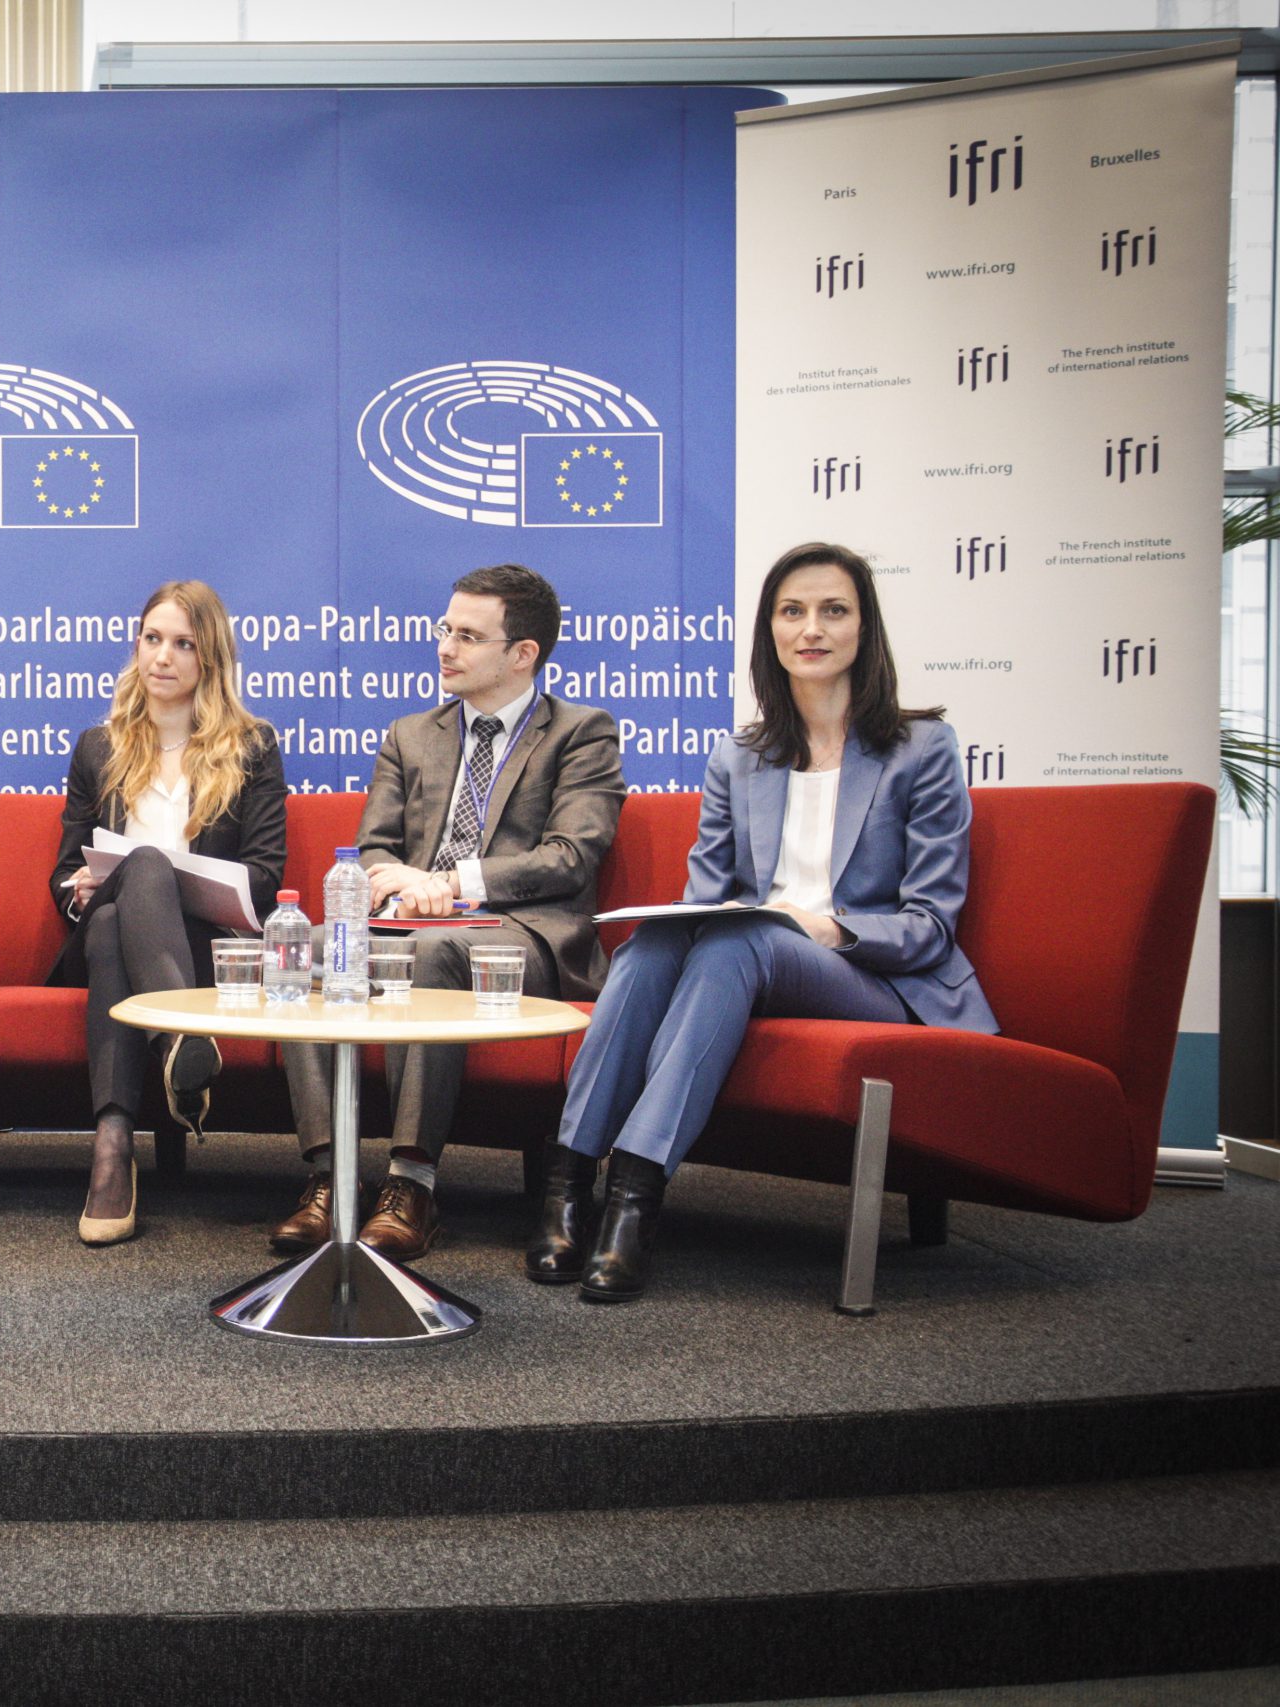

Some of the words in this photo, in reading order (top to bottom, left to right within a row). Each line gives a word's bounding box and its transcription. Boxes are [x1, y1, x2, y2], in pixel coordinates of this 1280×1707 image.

[949, 135, 1023, 206] ifri
[1090, 149, 1160, 168] Bruxelles
[824, 186, 857, 200] Paris
[1101, 226, 1156, 277] ifri
[816, 252, 864, 298] ifri
[926, 261, 1015, 279] www.ifri.org
[1048, 363, 1059, 373] of
[1062, 357, 1135, 372] international
[1138, 353, 1189, 365] relations
[1061, 348, 1082, 358] The
[1085, 344, 1123, 356] French
[1126, 340, 1175, 352] institute
[798, 369, 835, 380] Institut
[838, 366, 878, 377] français
[958, 345, 1008, 392] ifri
[766, 386, 784, 396] des
[786, 382, 830, 394] relations
[832, 376, 912, 390] internationales
[924, 463, 1013, 478] www.ifri.org
[1105, 435, 1159, 483] ifri
[813, 456, 861, 500] ifri
[956, 535, 1006, 580] ifri
[1045, 556, 1057, 566] of
[1059, 553, 1132, 565] international
[1135, 551, 1185, 562] relations
[1059, 542, 1080, 551] The
[1082, 540, 1120, 551] French
[1123, 538, 1171, 549] institute
[557, 605, 733, 651] Europäisch
[924, 658, 1012, 672] www.ifri.org
[1103, 638, 1156, 684] ifri
[236, 662, 352, 698] lement
[544, 661, 718, 698] Parlaimint
[619, 718, 729, 755] Parlam
[965, 744, 1004, 787] fri
[1043, 767, 1054, 776] of
[1057, 767, 1130, 776] international
[1133, 766, 1183, 776] relations
[1057, 753, 1077, 762] The
[1080, 752, 1119, 762] French
[1121, 752, 1169, 762] institute
